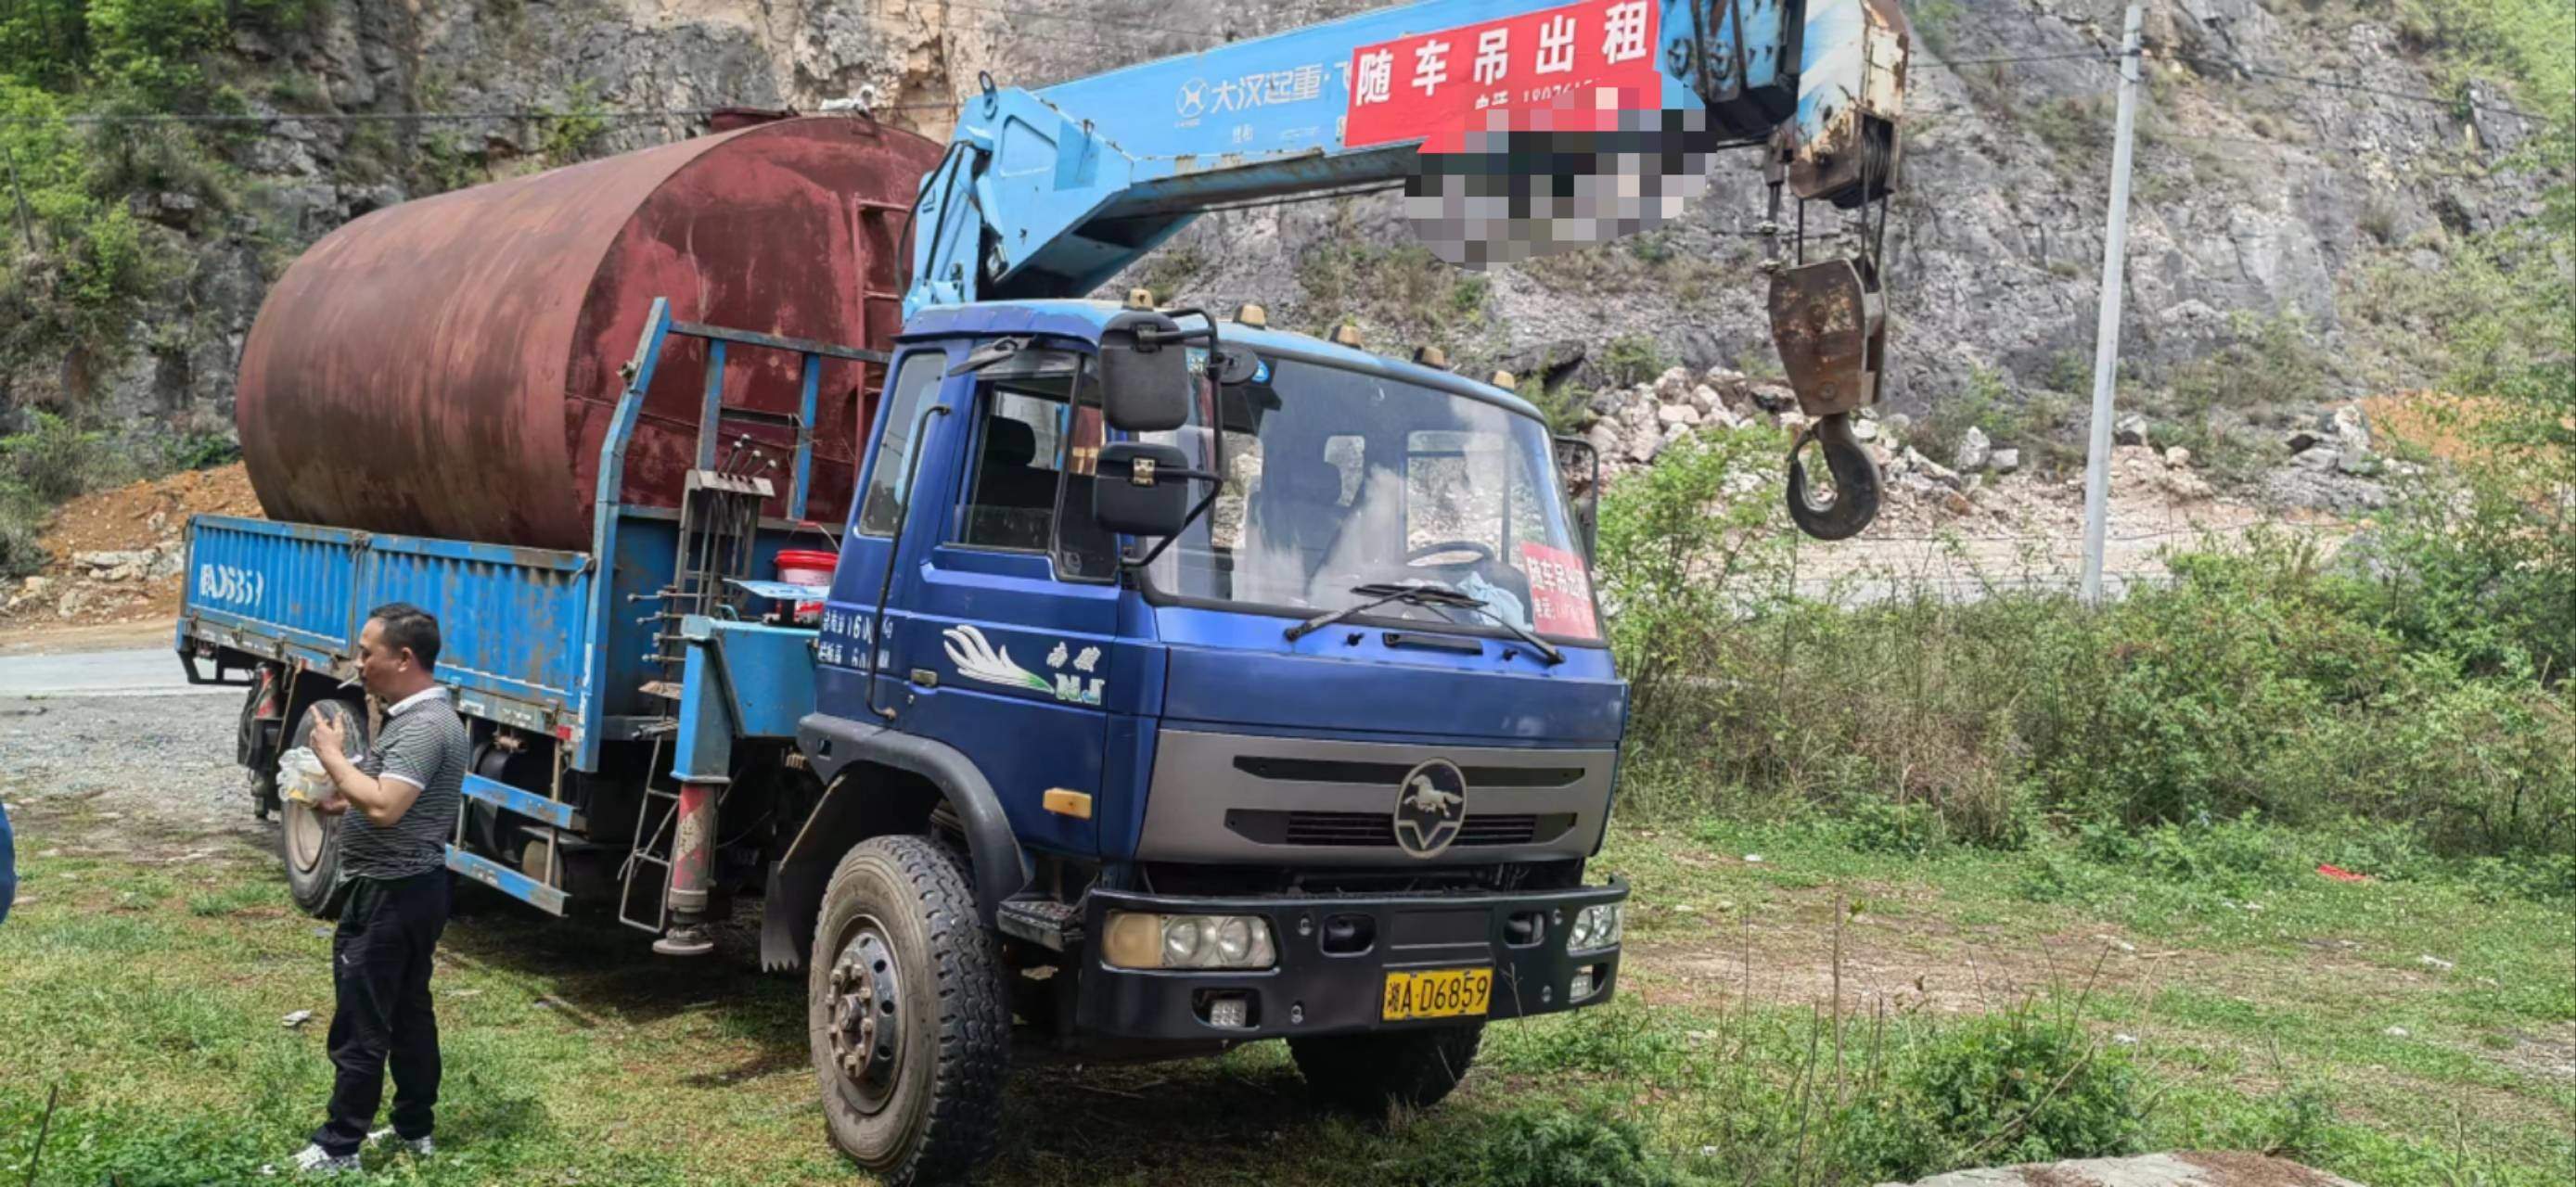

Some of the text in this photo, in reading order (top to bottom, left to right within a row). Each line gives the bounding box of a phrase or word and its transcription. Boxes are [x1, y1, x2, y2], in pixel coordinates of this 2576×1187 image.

[1355, 1, 1648, 107] 随车吊出租
